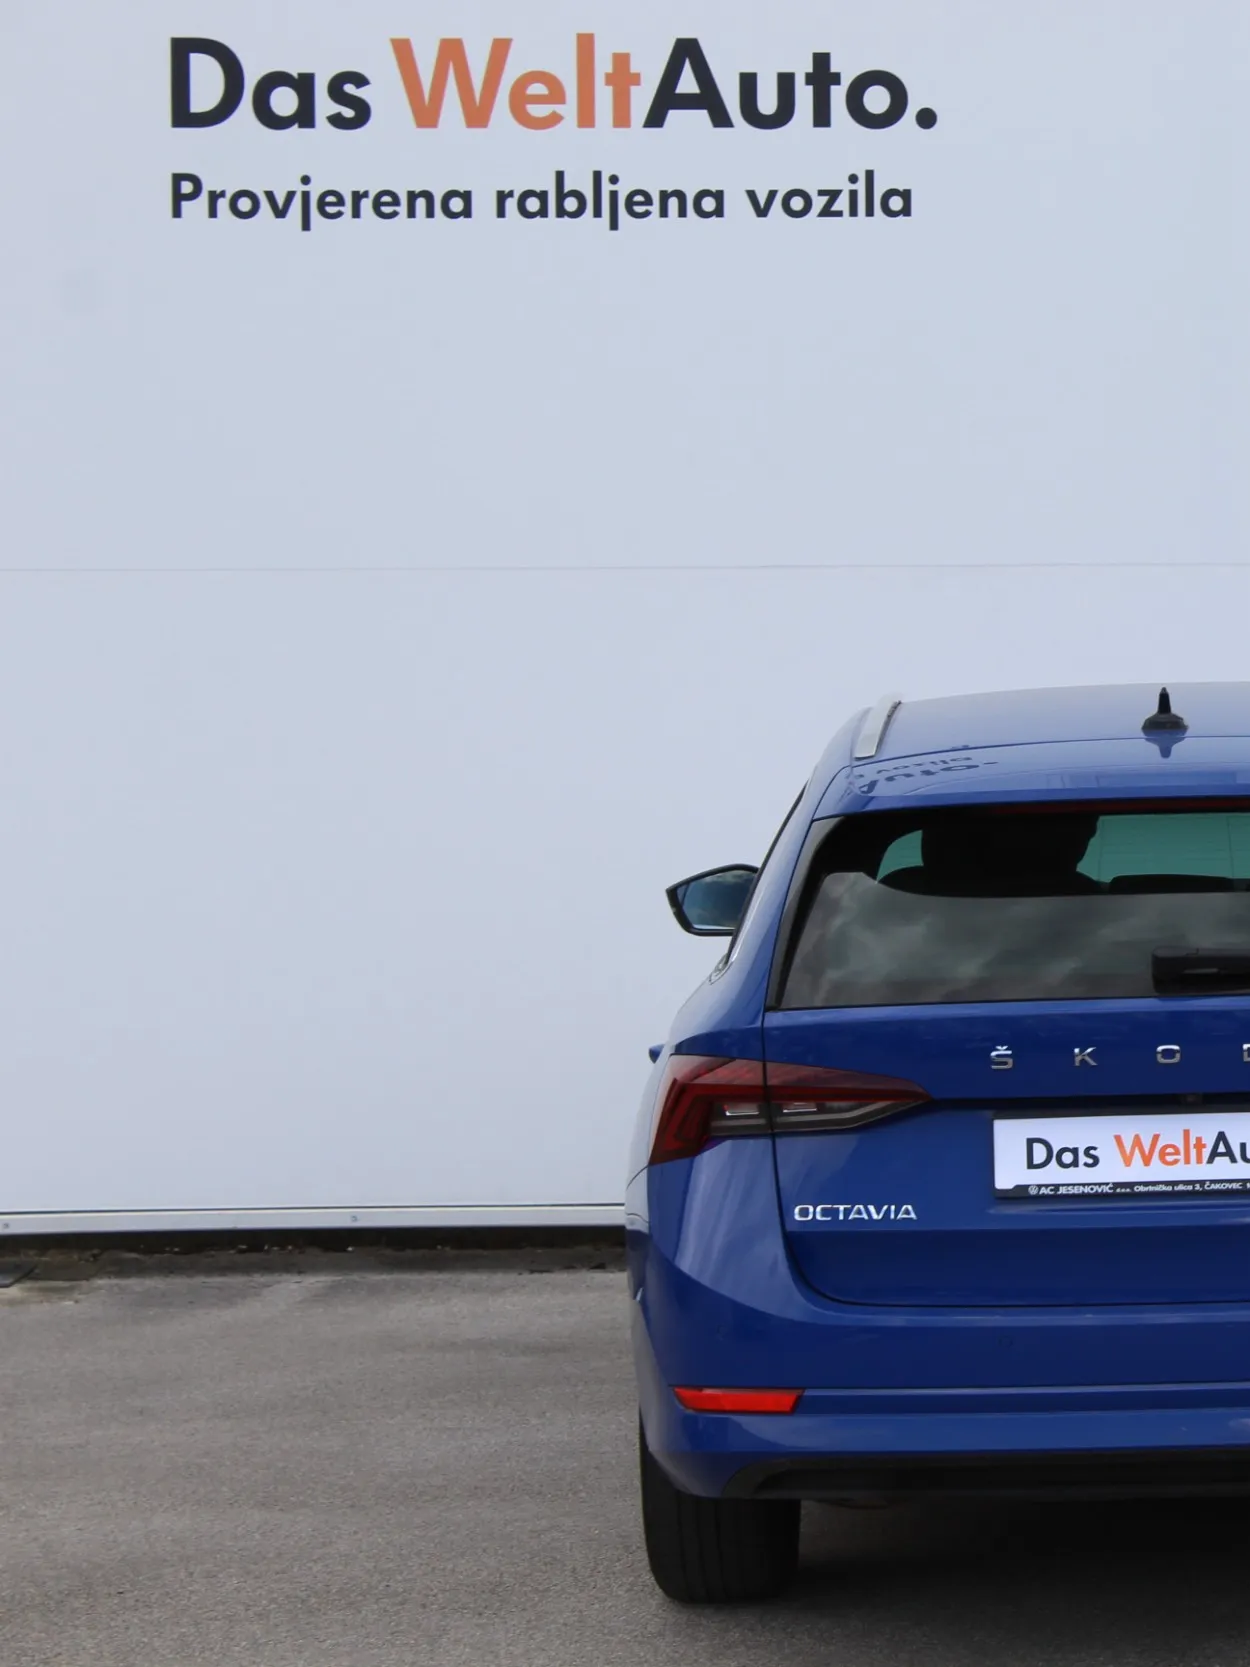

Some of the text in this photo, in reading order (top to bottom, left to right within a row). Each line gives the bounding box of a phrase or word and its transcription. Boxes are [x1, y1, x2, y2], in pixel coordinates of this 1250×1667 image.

[171, 33, 938, 131] Das WeltAuto.
[171, 169, 912, 232] Provjerena rabljena vozila
[1025, 1137, 1100, 1170] Das
[1039, 1186, 1055, 1195] AC
[1057, 1183, 1113, 1194] JESENOVIĆ
[1174, 1183, 1193, 1191] ulica
[1204, 1180, 1243, 1190] ČAKOVEC
[794, 1204, 918, 1221] OCTAVIA
